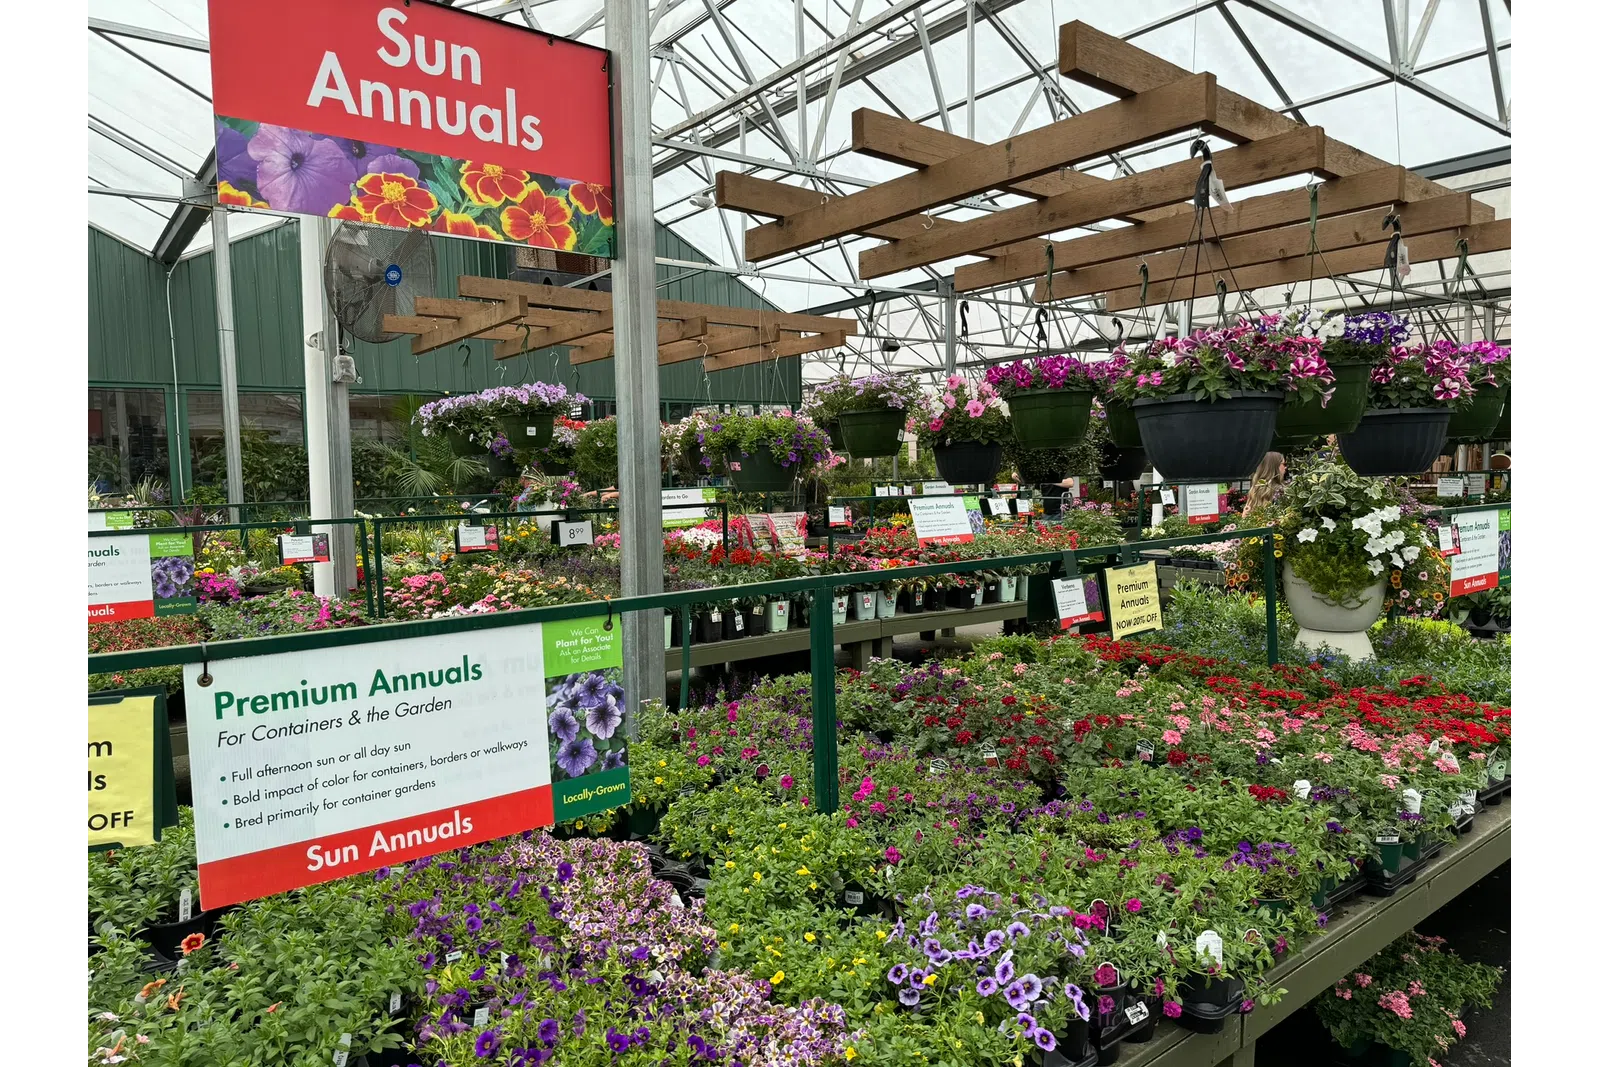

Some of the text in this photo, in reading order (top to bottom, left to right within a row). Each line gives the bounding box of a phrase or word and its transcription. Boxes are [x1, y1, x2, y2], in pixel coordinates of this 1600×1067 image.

[376, 7, 482, 85] Sun
[306, 50, 543, 151] Annuals
[1459, 522, 1473, 533] emium
[1474, 518, 1490, 531] Annuals
[88, 545, 120, 557] nuals
[1117, 580, 1149, 594] Premium
[1471, 575, 1486, 587] Annuals
[88, 605, 115, 617] nuals
[1120, 595, 1149, 610] Annuals
[1116, 613, 1157, 630] NOW 20% OFF
[570, 626, 599, 637] We Can
[555, 633, 614, 649] Plant for You!
[559, 649, 572, 657] Ask
[582, 644, 612, 653] Associate
[570, 653, 602, 664] for Details
[214, 654, 482, 720] Premium Annuals
[217, 696, 452, 748] For Containers & the Garden
[231, 742, 411, 783] Full afternoon sun or all day sun
[233, 739, 528, 806] Bold impact of color for containers, borders or walkways
[563, 782, 626, 804] Locally-Grown
[235, 779, 436, 829] Bred primarily for container gardens
[88, 810, 134, 831] OFF
[306, 809, 473, 871] Sun Annuals
